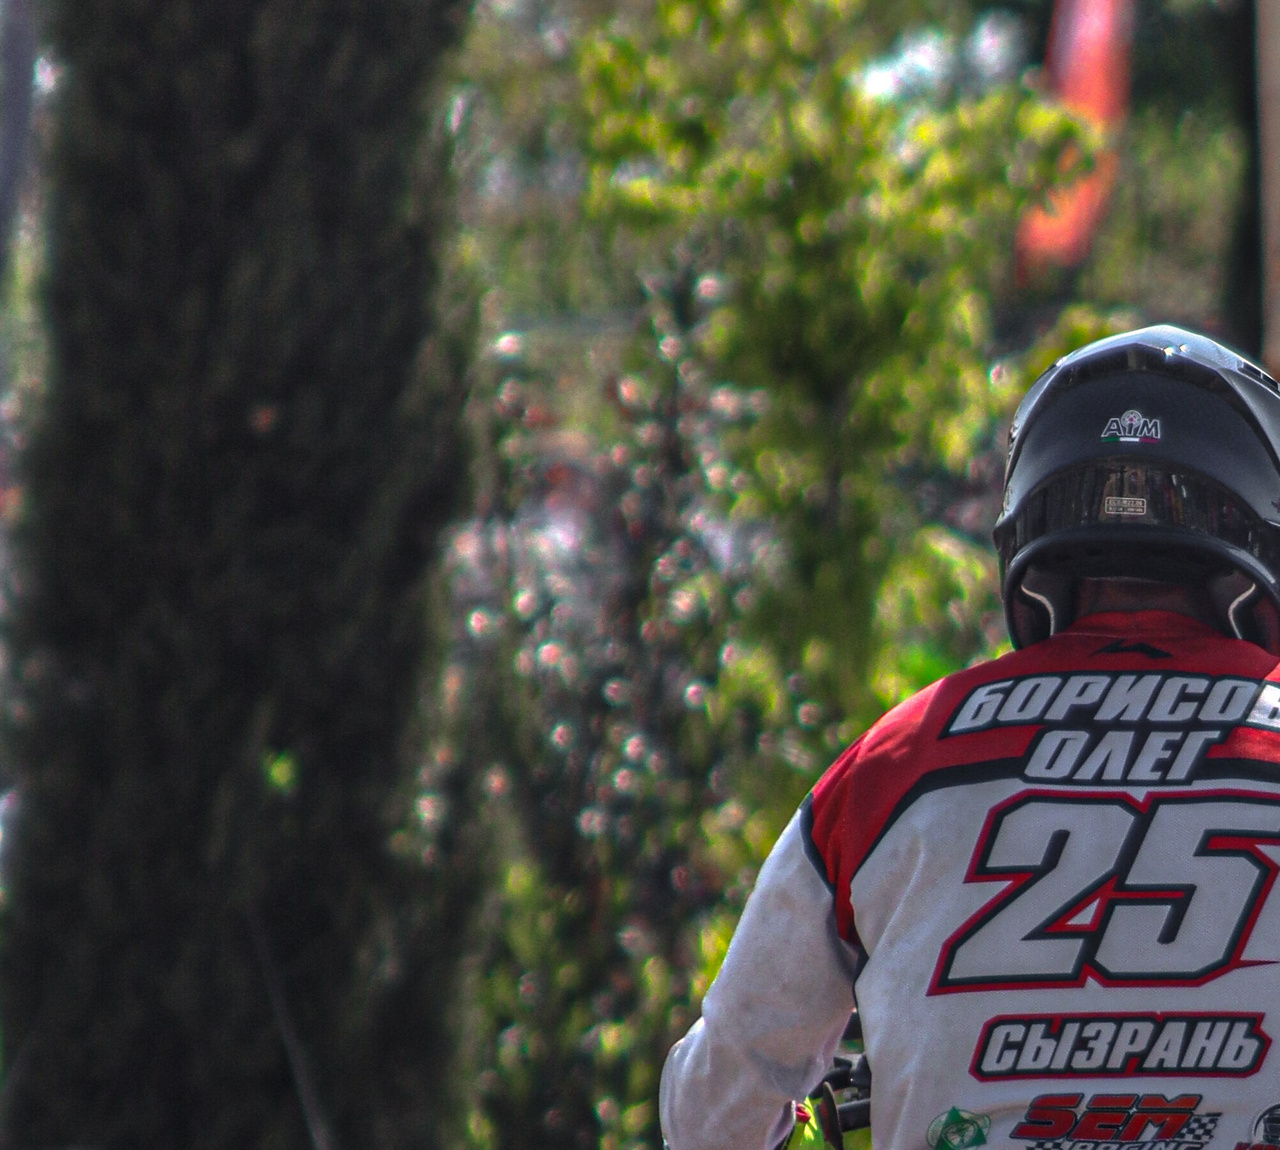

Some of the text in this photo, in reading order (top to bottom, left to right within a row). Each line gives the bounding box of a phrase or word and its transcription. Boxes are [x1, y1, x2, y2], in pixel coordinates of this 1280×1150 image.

[1024, 729, 1221, 781] ОЛЕГ
[979, 1018, 1265, 1073] СЫЗРАНЬ
[1010, 1093, 1201, 1140] SEM
